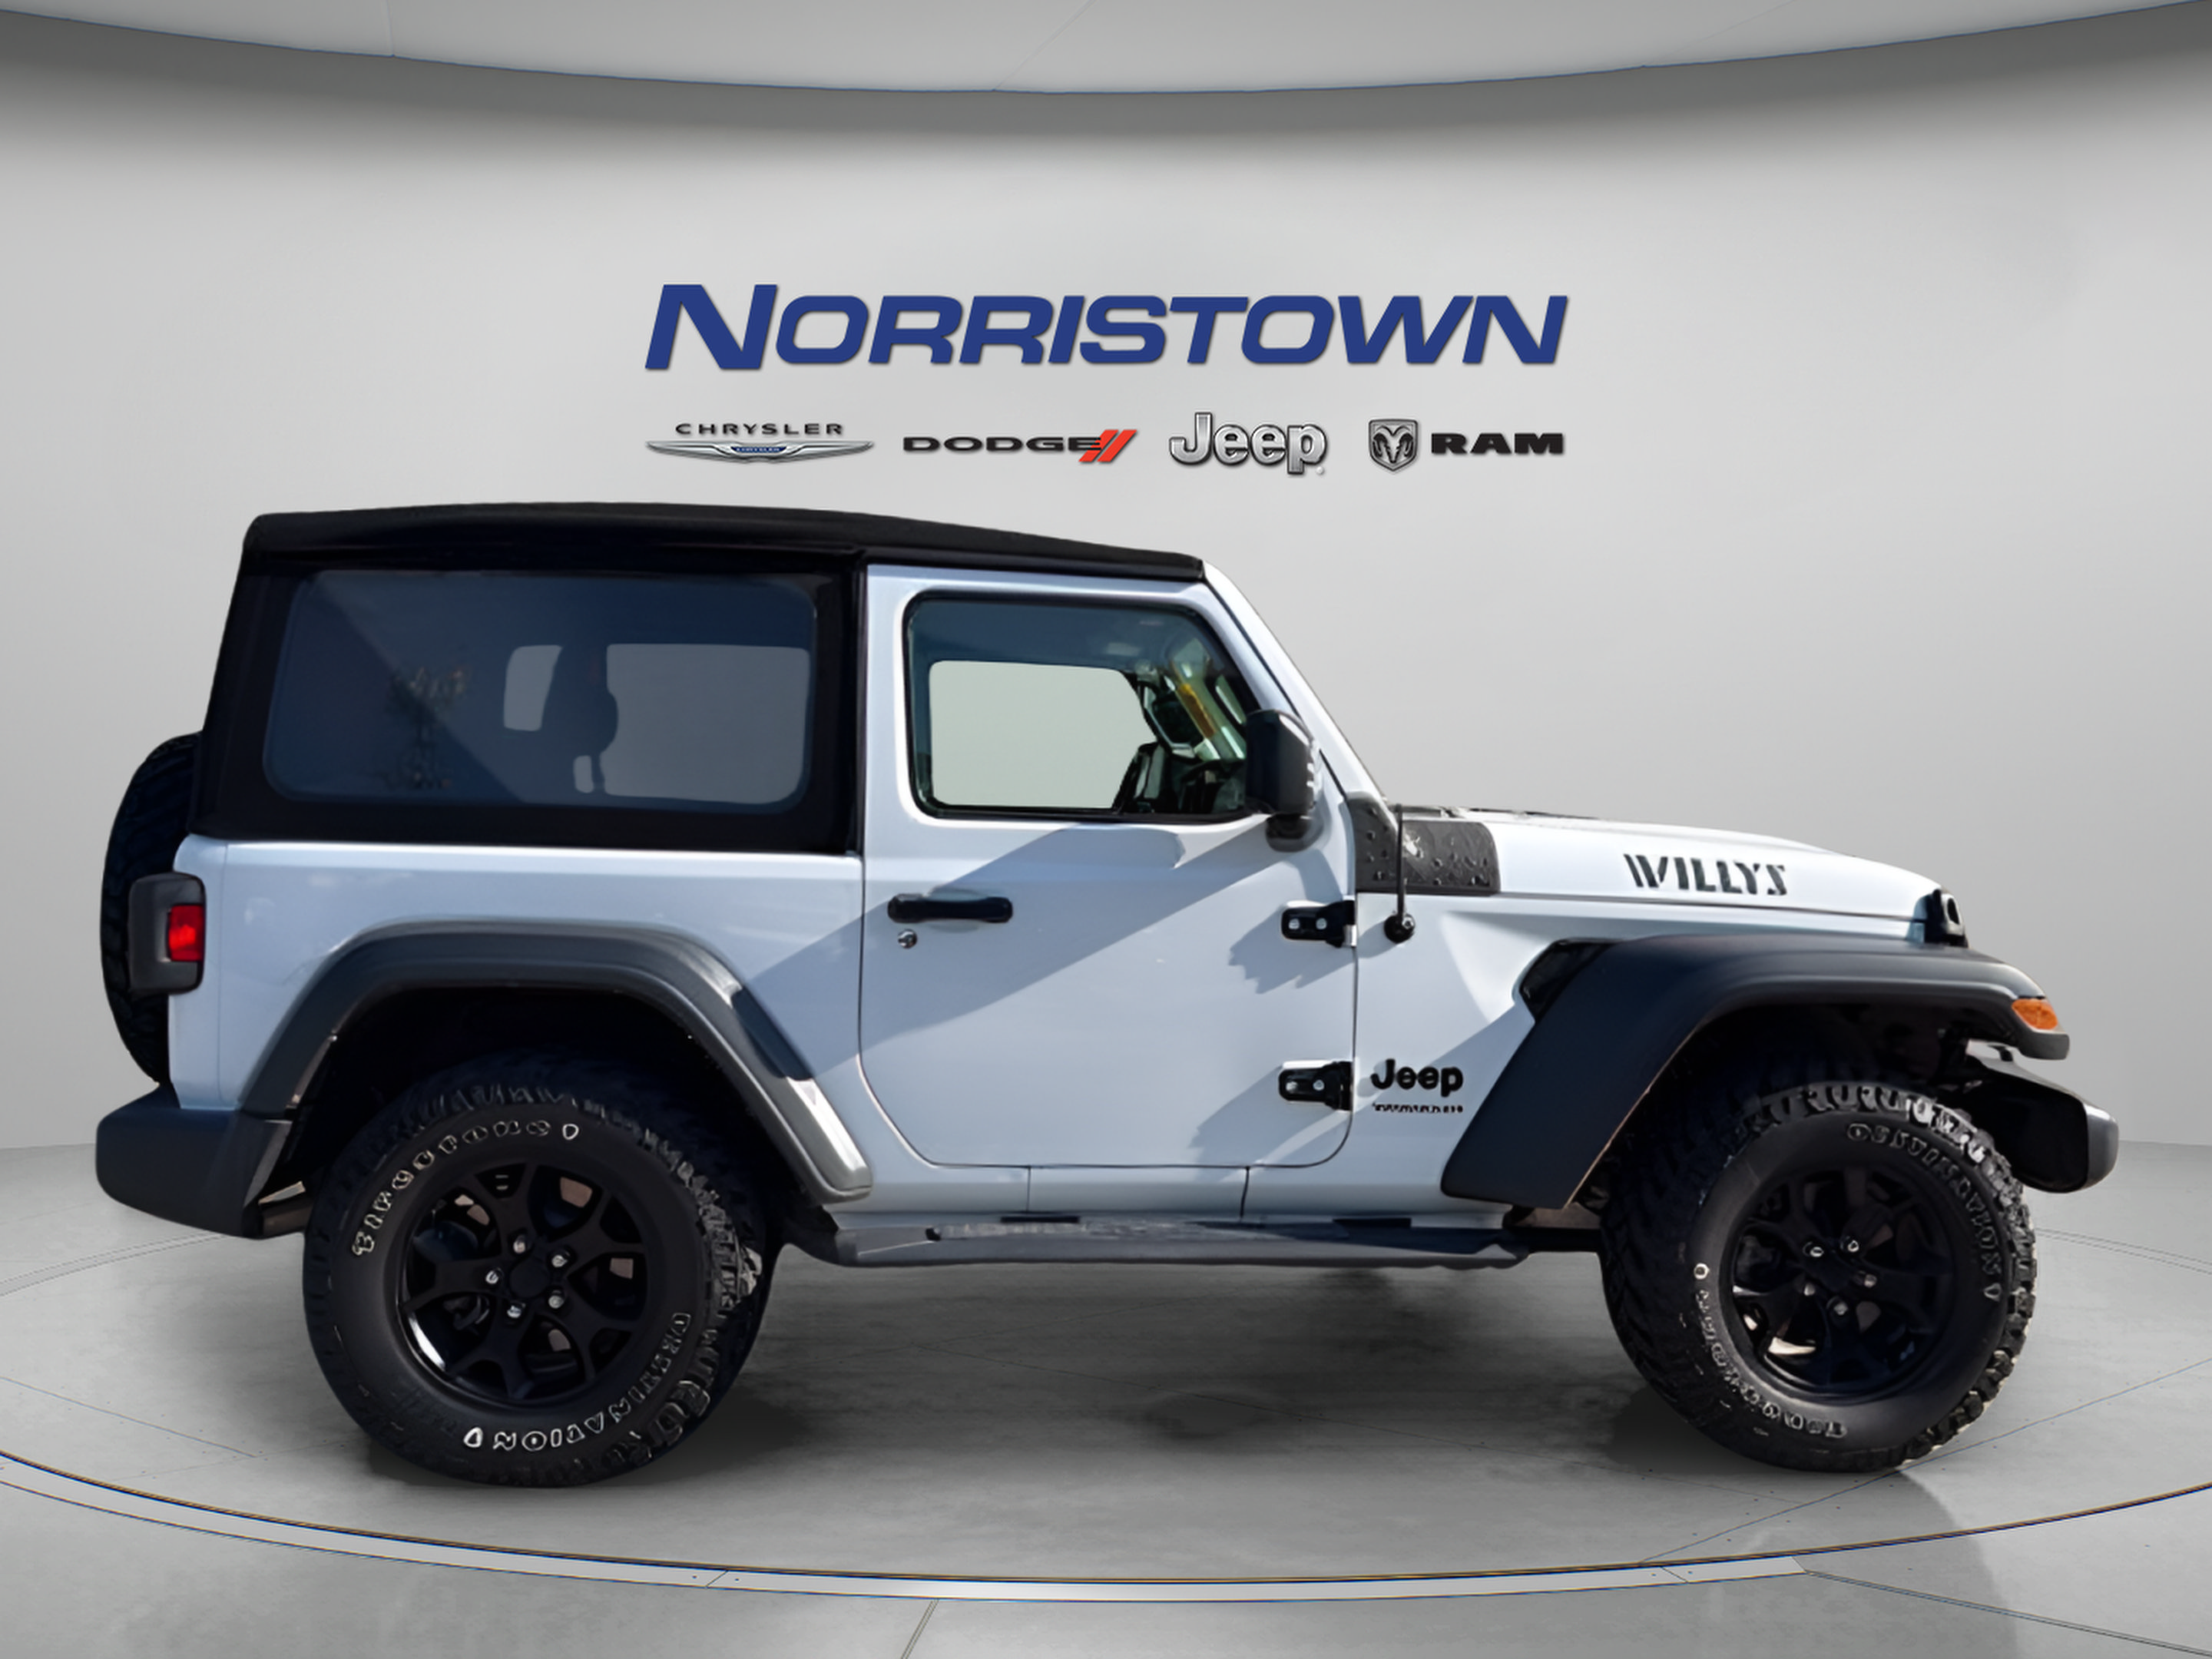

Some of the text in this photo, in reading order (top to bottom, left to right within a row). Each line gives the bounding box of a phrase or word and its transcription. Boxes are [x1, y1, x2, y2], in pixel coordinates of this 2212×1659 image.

[645, 285, 1567, 368] NORRISTOWN
[675, 423, 843, 435] CHRYSLER
[903, 436, 1101, 452] DODGE
[1169, 412, 1328, 475] Jeep
[1432, 433, 1563, 454] RAM
[1624, 855, 1786, 895] WILLYS
[1371, 1059, 1463, 1097] Jeep
